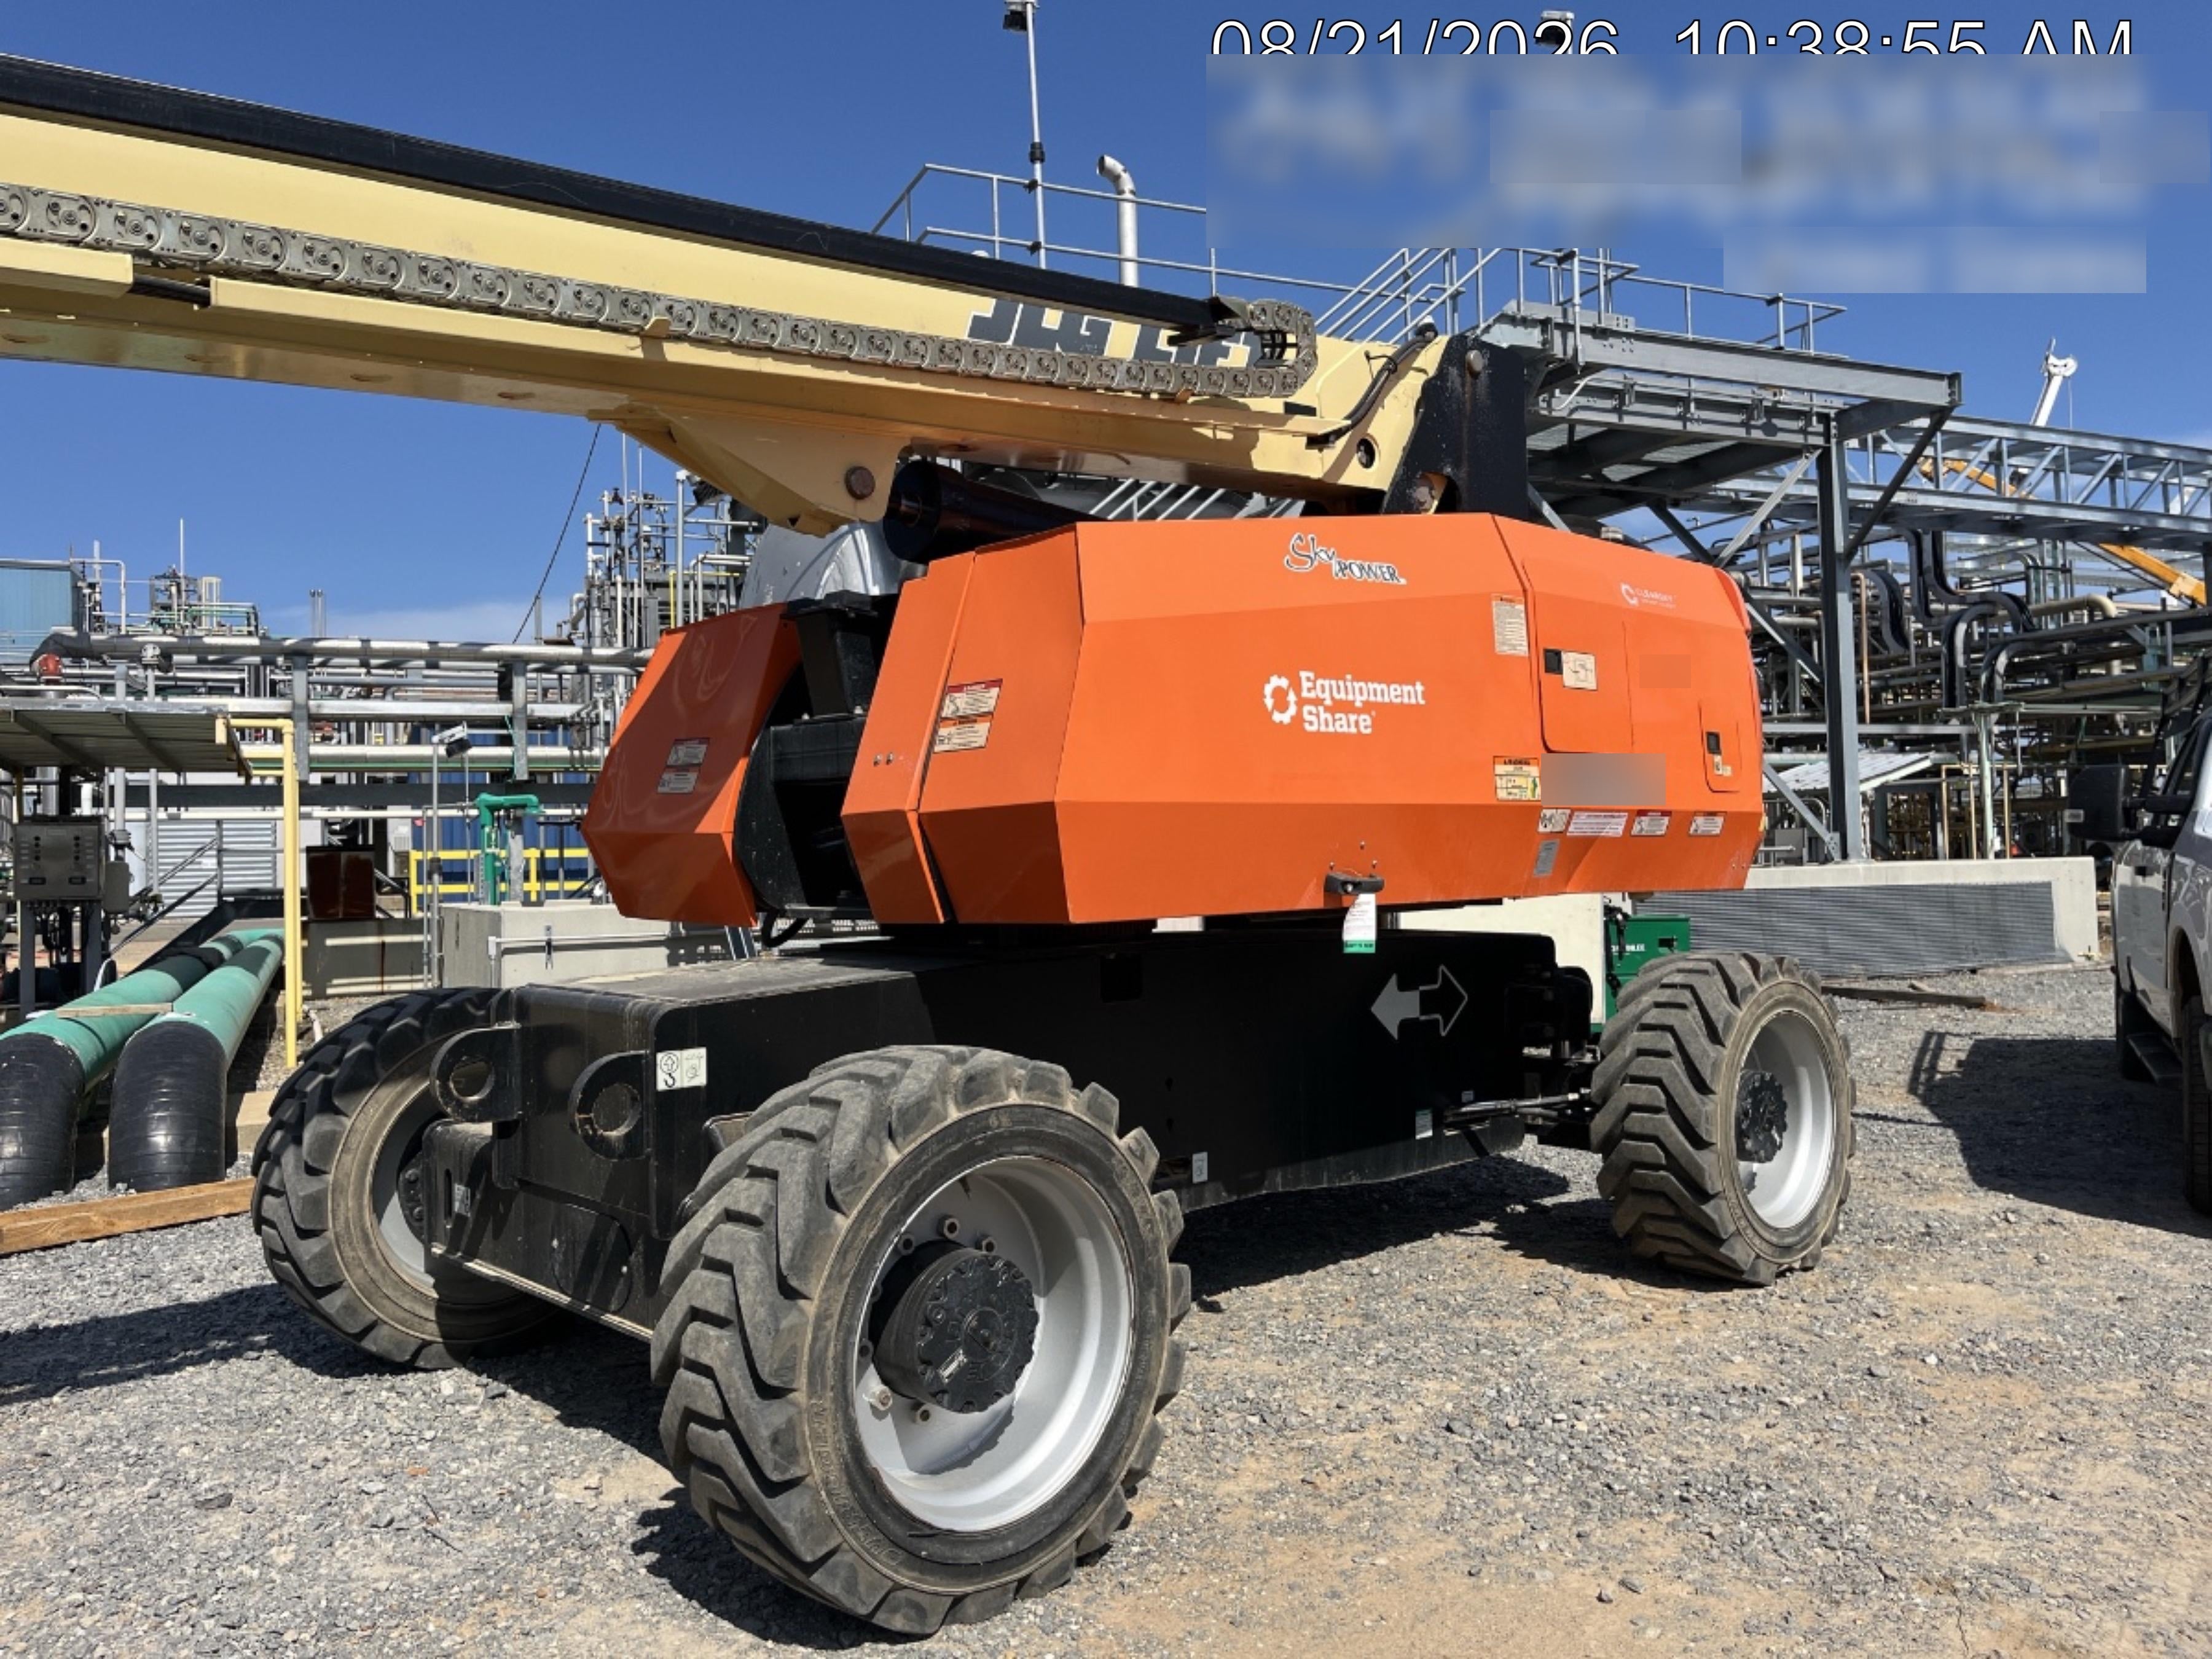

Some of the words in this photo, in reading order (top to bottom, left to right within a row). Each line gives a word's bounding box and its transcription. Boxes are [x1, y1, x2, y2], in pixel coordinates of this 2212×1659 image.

[1333, 558, 1406, 585] POWER
[1299, 670, 1426, 707] Equipment
[1301, 704, 1373, 734] Share
